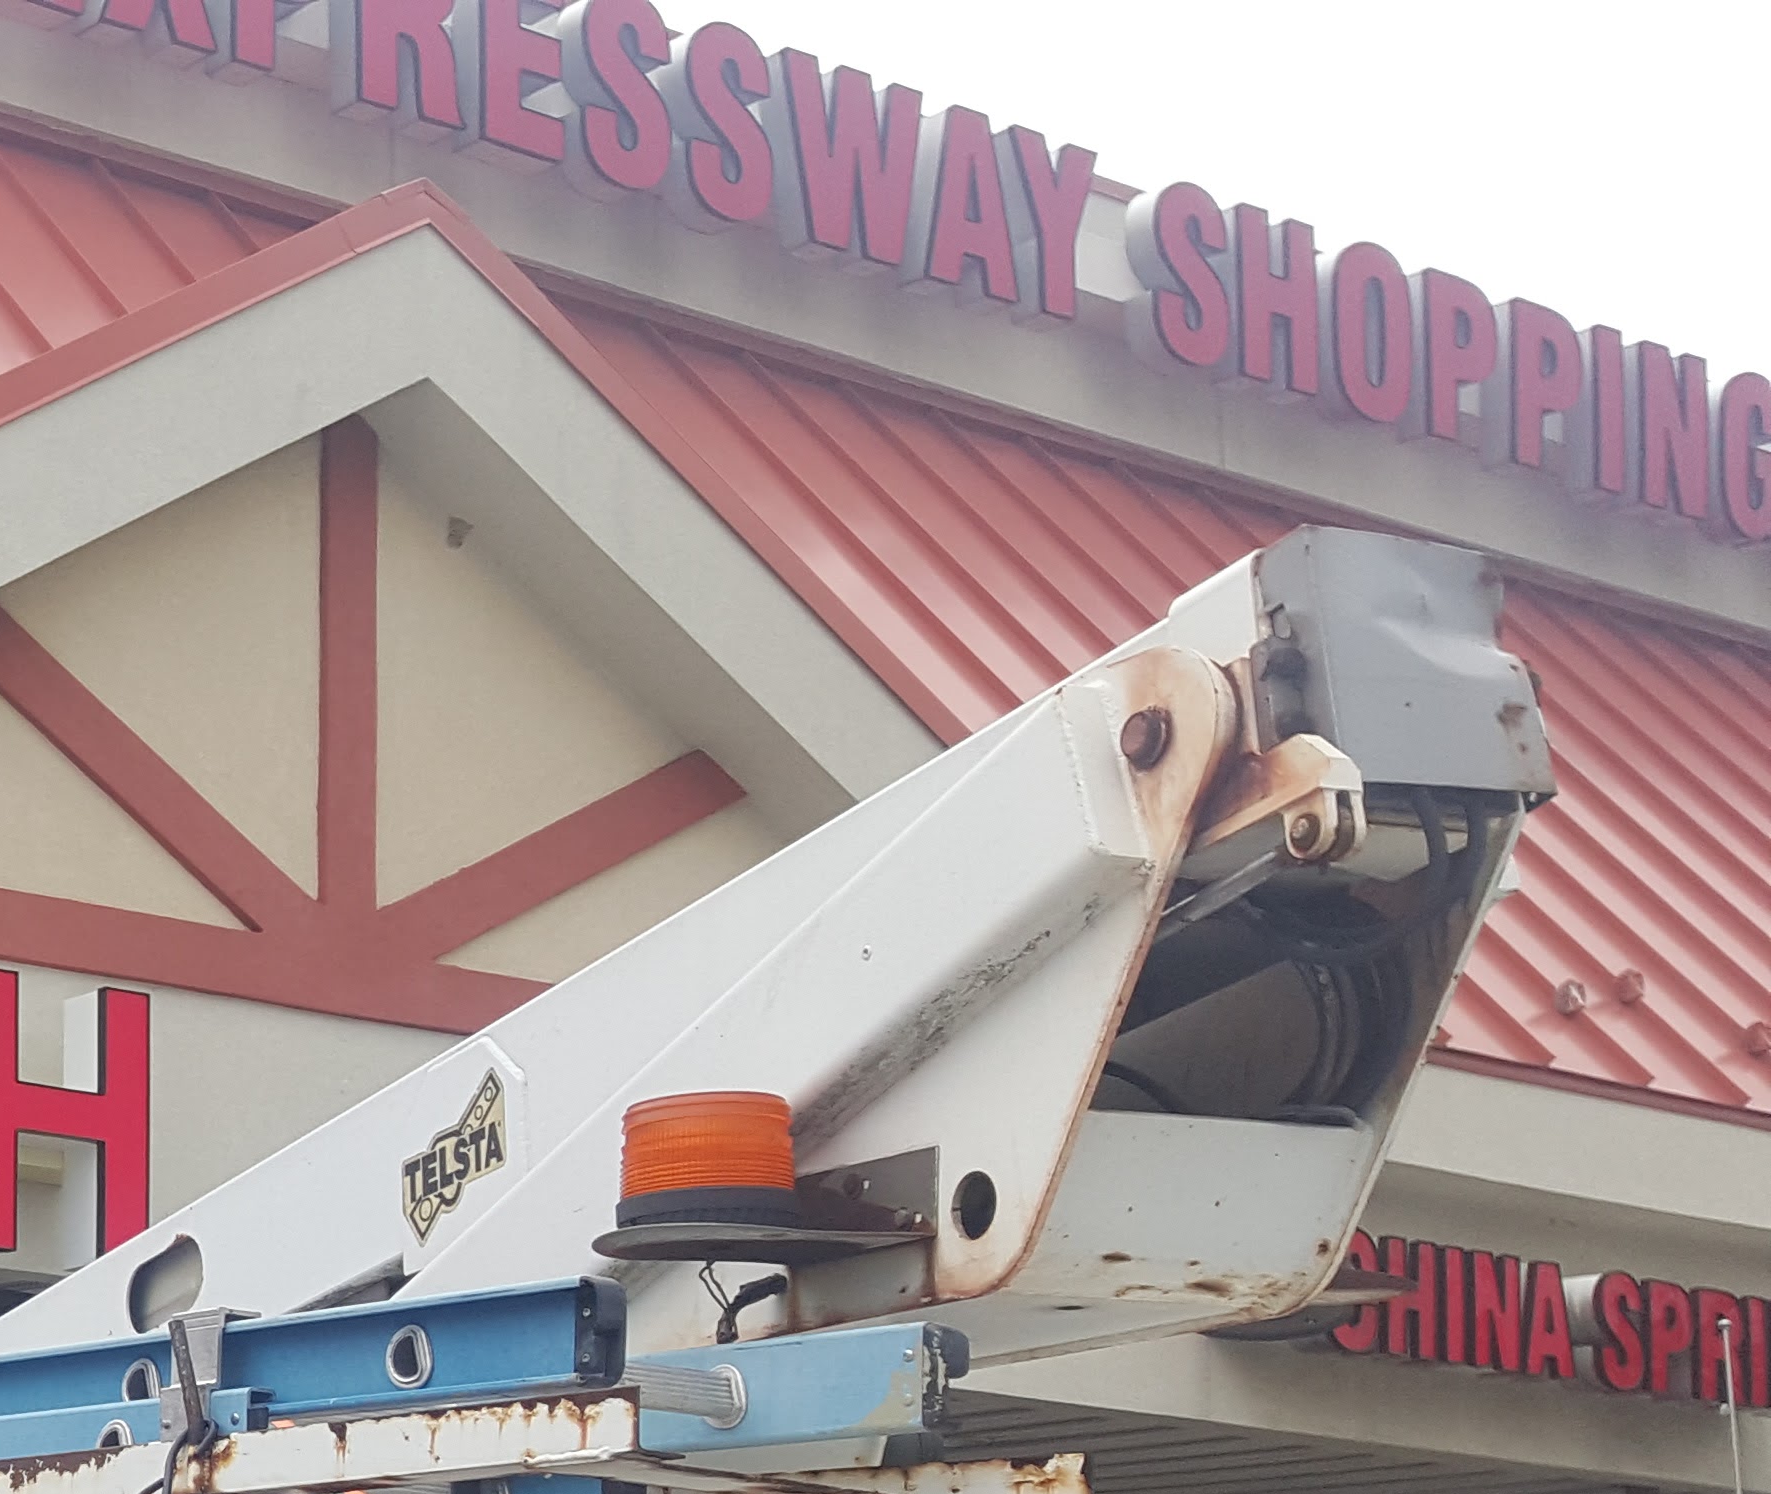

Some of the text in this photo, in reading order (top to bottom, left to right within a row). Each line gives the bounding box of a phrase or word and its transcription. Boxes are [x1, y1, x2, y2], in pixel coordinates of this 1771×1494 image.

[21, 0, 1771, 541] RESSWAY SHOPPING
[404, 1120, 504, 1204] TELSTA
